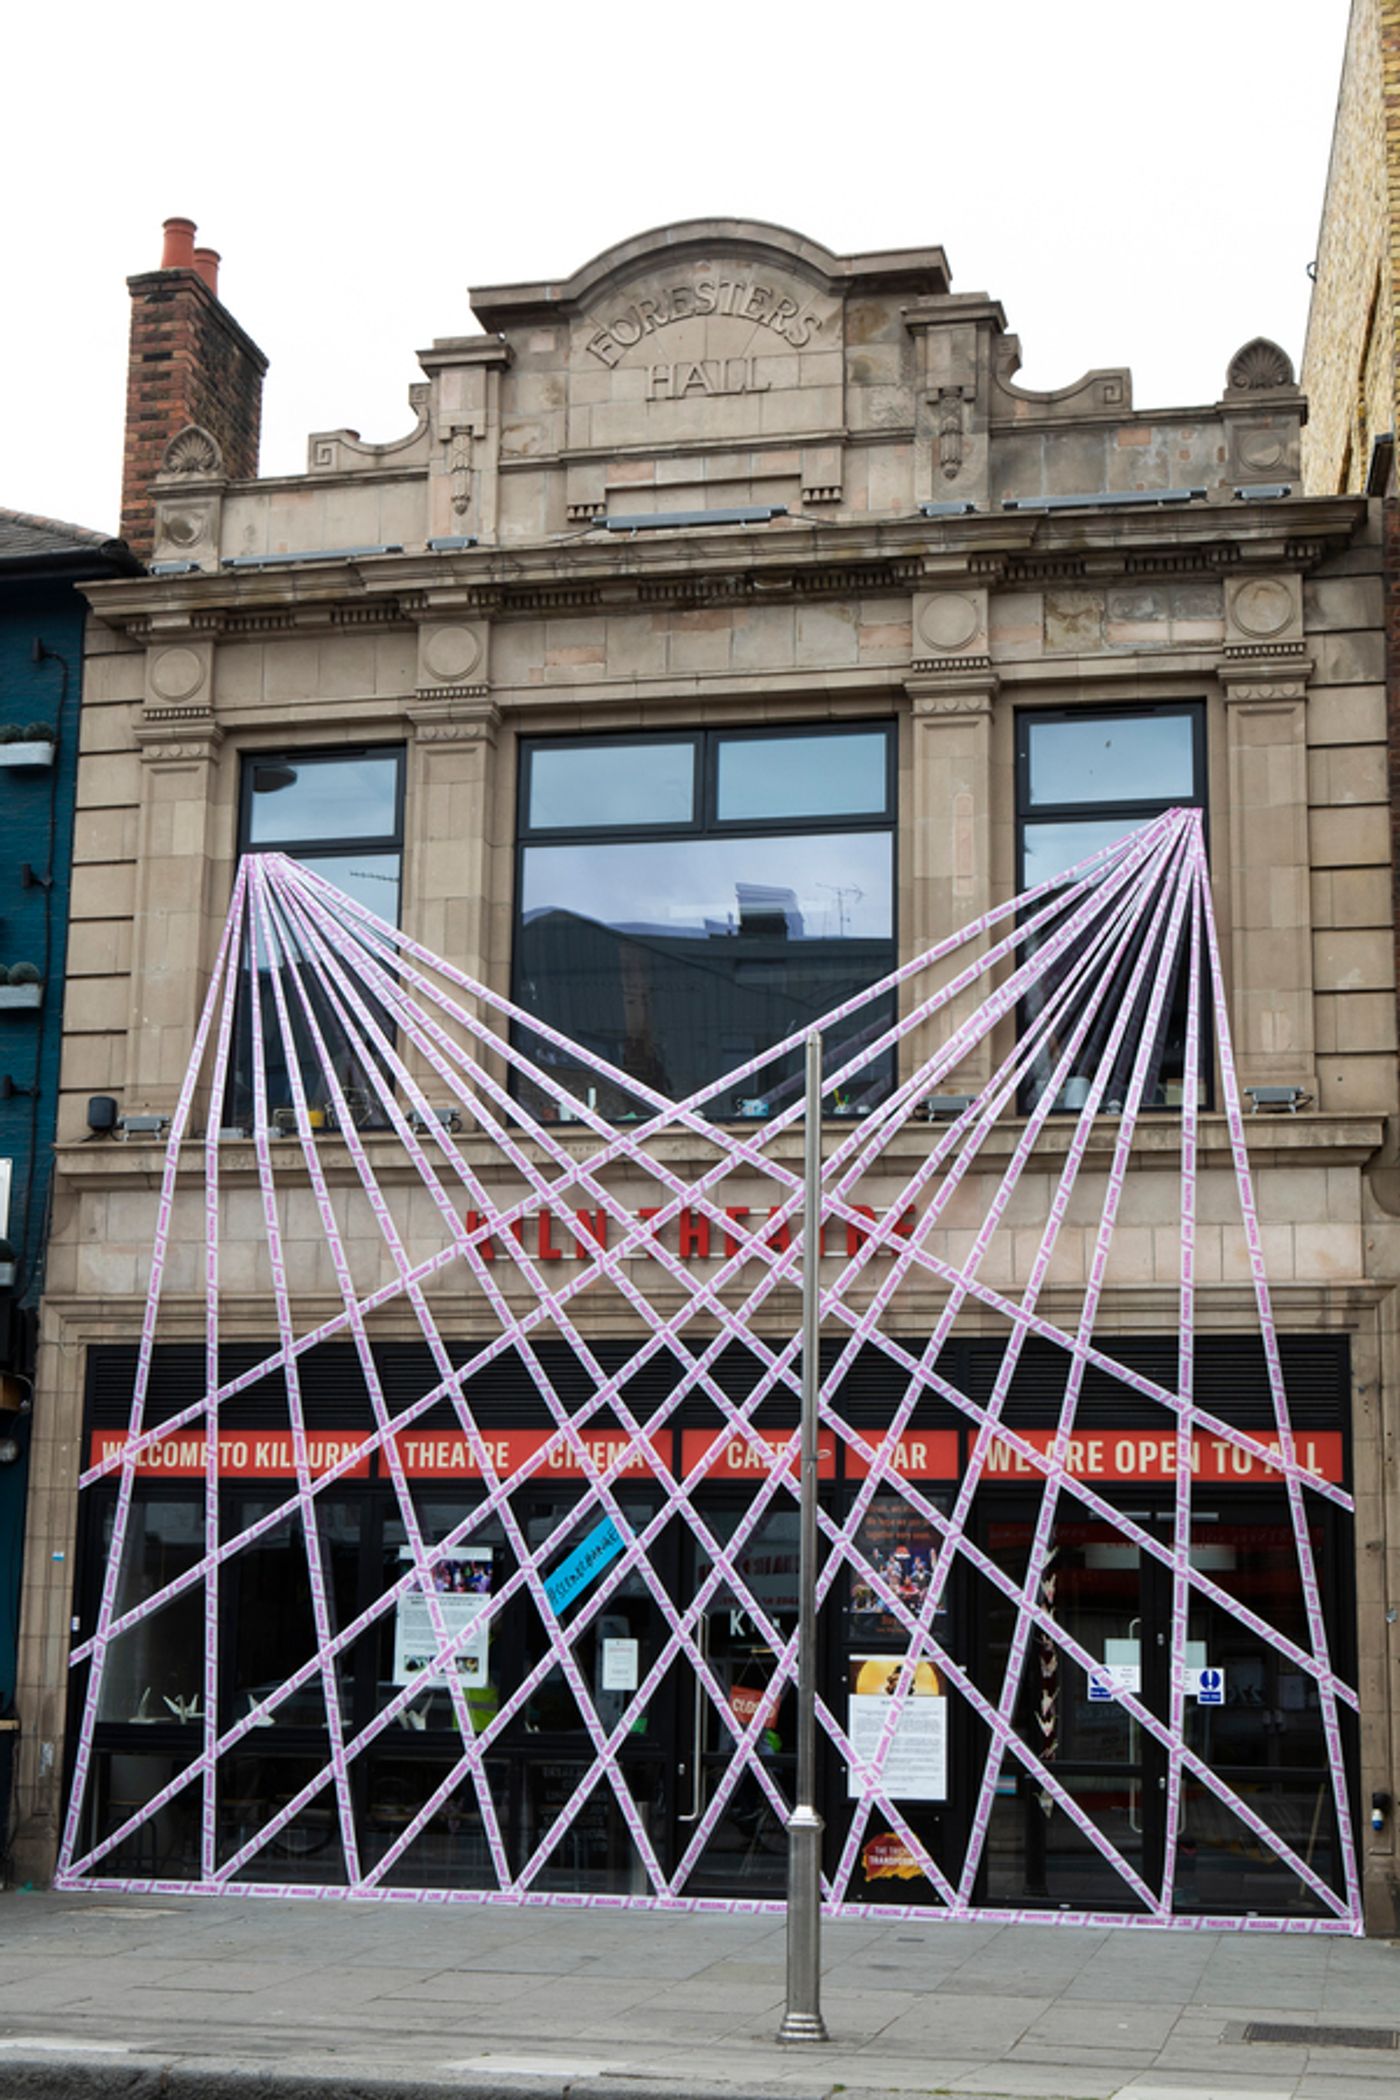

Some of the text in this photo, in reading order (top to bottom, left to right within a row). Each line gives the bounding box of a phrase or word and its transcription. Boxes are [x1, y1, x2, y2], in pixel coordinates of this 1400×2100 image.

[586, 280, 822, 369] FORESTERS
[644, 356, 772, 402] HALL
[637, 1205, 916, 1258] HEARE
[102, 1441, 357, 1468] WLCOME TO KILURN
[877, 1442, 927, 1469] AR
[1211, 1441, 1253, 1474] TO
[1264, 1442, 1323, 1475] AL
[732, 1698, 777, 1718] CLOD
